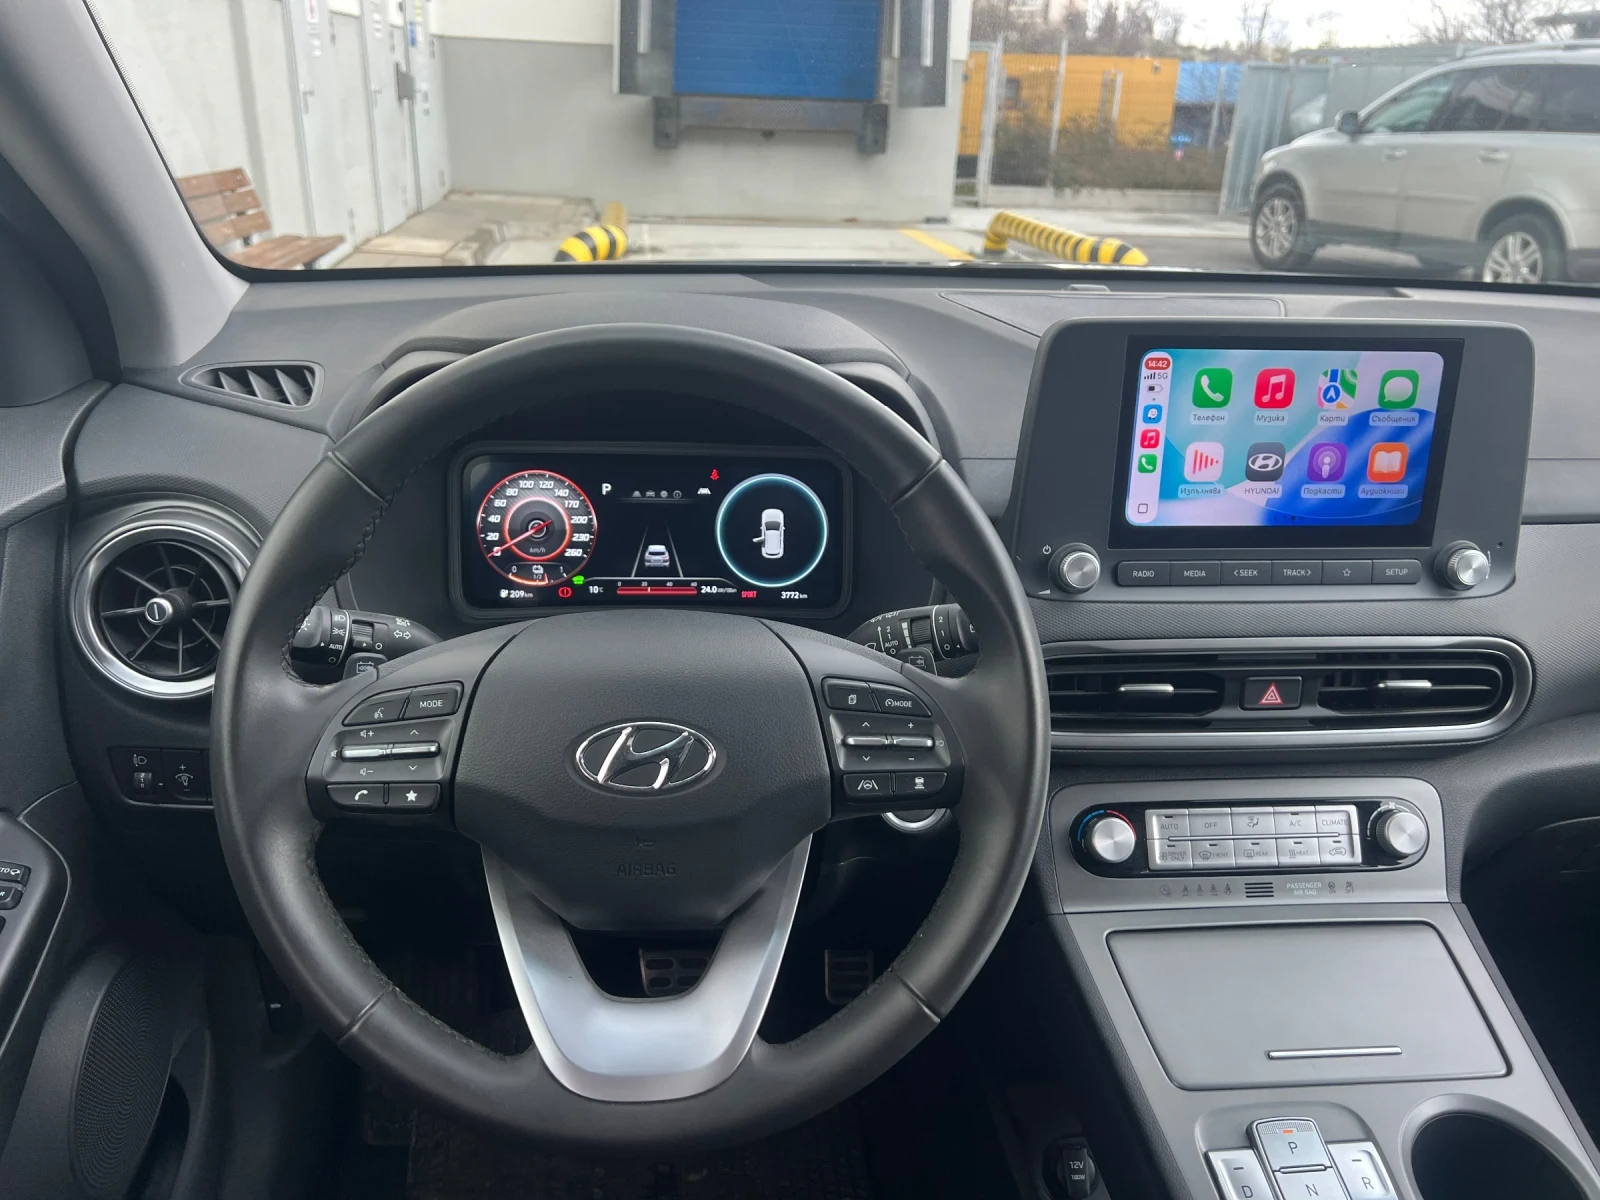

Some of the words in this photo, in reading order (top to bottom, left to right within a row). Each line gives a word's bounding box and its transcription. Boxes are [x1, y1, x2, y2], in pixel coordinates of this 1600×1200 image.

[1192, 414, 1225, 422] Телефон
[1256, 414, 1285, 423] Музика
[1320, 415, 1346, 424] Карти
[1372, 415, 1416, 423] Съобщения
[519, 480, 534, 488] 100
[539, 480, 554, 489] 120
[554, 489, 569, 497] 140
[602, 483, 612, 495] P
[1180, 488, 1221, 496] Изпълнява
[564, 500, 579, 508] 170
[488, 515, 500, 523] 40
[570, 516, 588, 524] 200
[572, 533, 590, 541] 230
[564, 548, 582, 556] 260
[420, 700, 443, 708] MODE
[616, 862, 676, 876] AIRBAG
[1288, 1141, 1298, 1154] P
[1362, 1176, 1374, 1190] R
[1241, 1185, 1253, 1199] D
[1305, 1184, 1319, 1197] N
